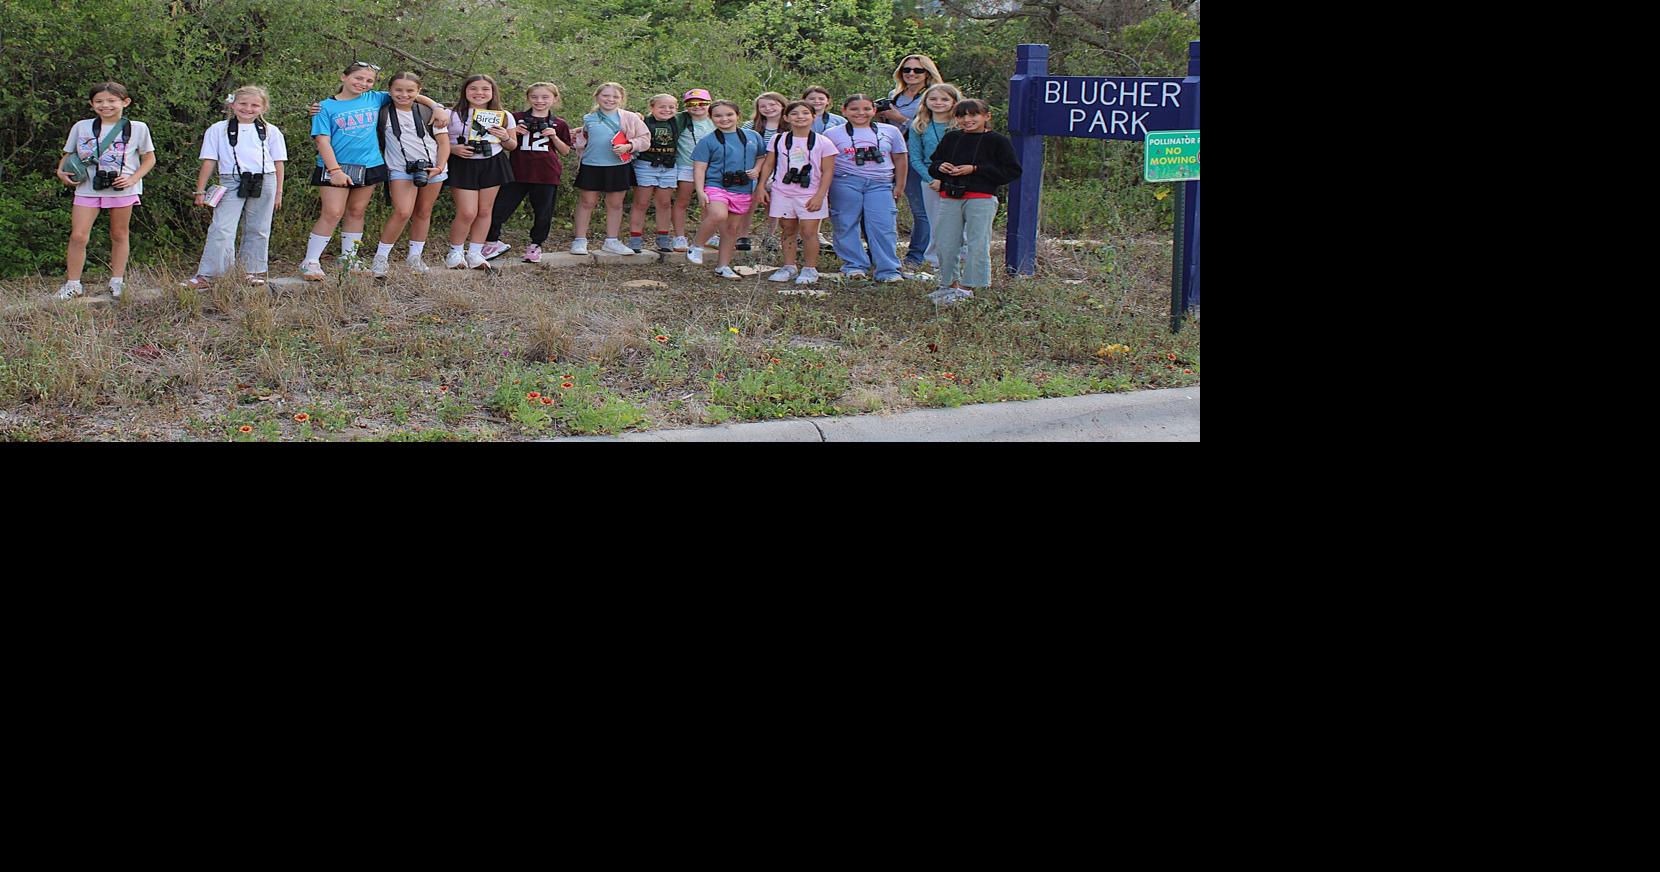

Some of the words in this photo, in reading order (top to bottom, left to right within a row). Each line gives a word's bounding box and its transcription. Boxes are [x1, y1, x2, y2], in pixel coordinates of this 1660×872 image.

[1045, 80, 1182, 107] BLUCHER
[475, 114, 500, 125] Birds
[1069, 109, 1150, 135] PARK
[519, 131, 549, 152] 12
[1149, 138, 1196, 146] POLLINATOR
[1165, 147, 1182, 155] NO
[1150, 156, 1197, 165] MOWING
